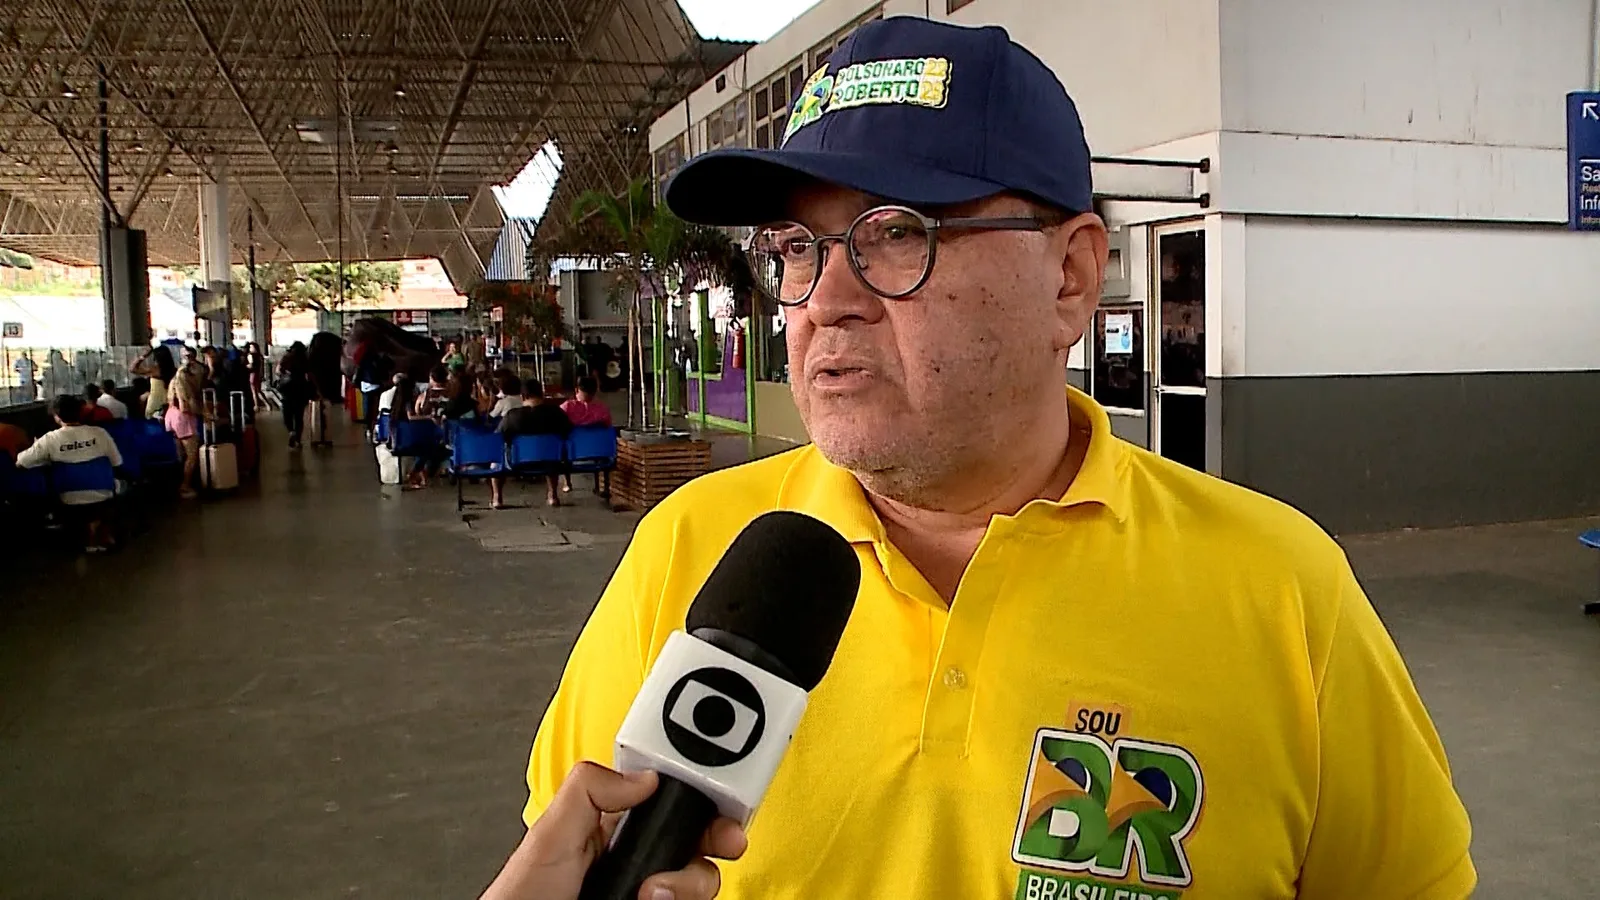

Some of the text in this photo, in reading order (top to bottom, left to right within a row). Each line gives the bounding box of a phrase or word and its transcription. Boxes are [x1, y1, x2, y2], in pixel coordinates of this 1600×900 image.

[925, 58, 946, 77] 22
[831, 80, 920, 104] ROBERTO
[1074, 708, 1122, 735] SOU
